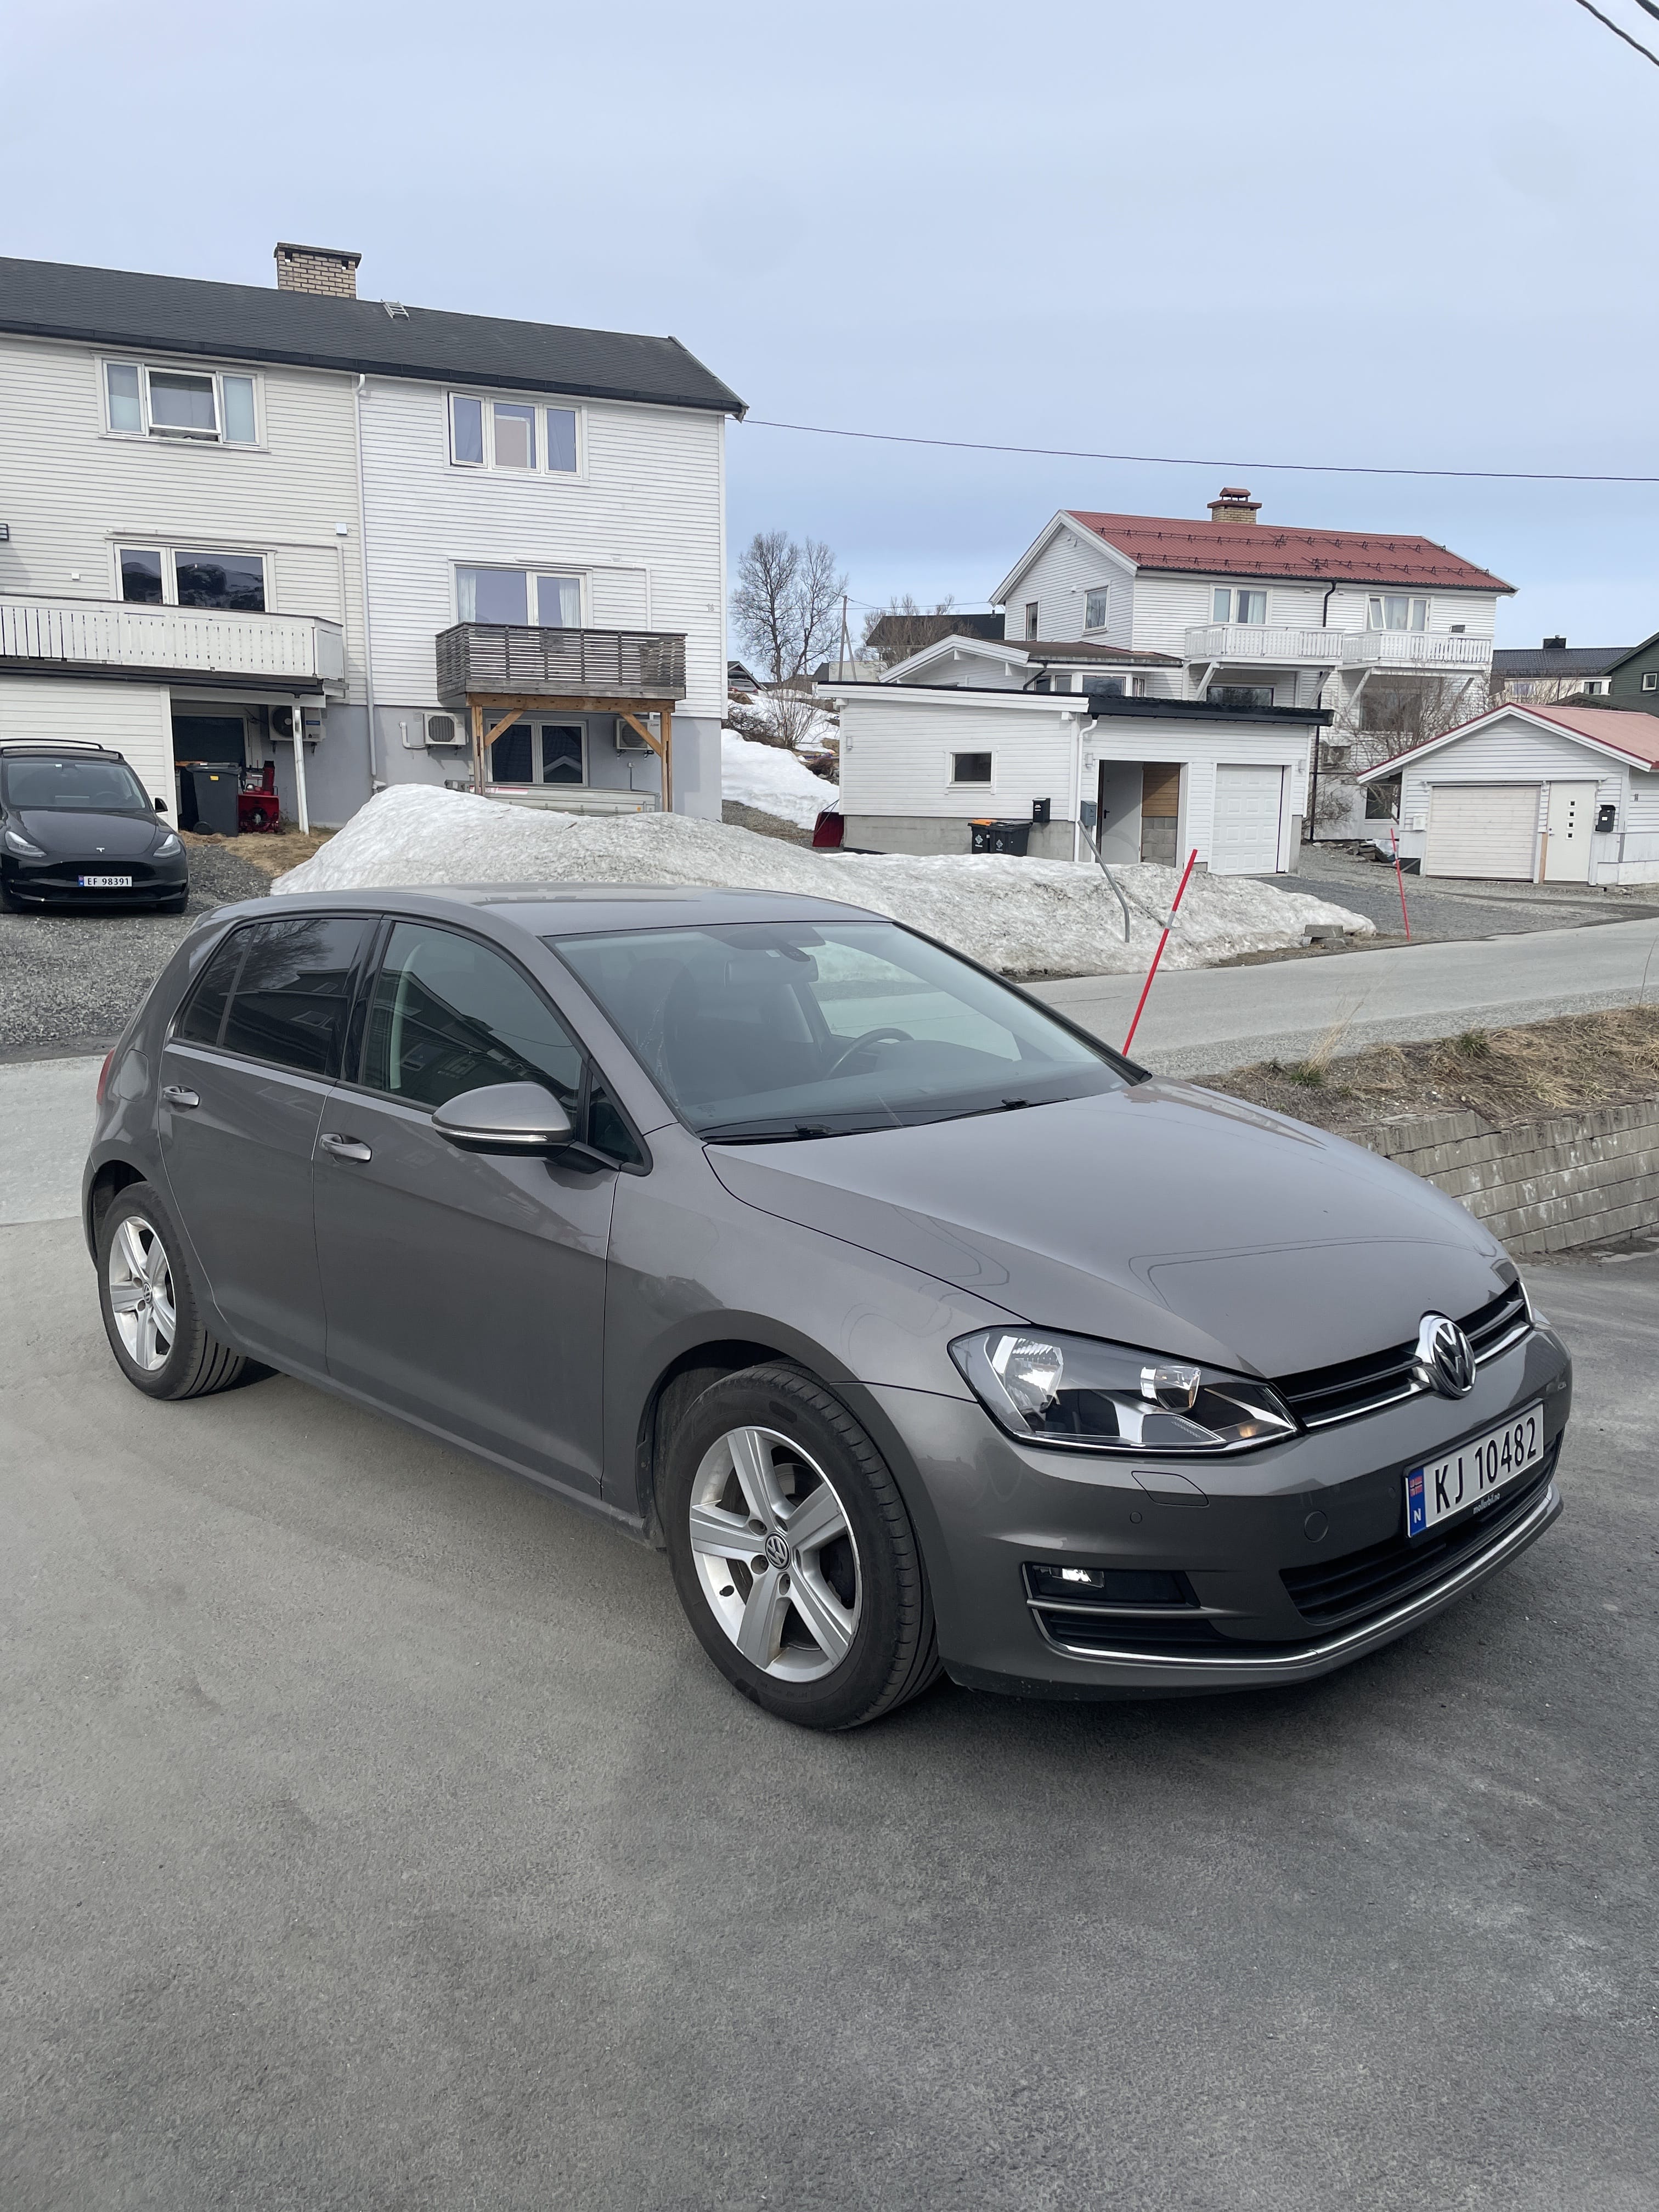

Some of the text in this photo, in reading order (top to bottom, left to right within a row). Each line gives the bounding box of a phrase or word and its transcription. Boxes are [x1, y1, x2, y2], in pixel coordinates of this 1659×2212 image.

[1435, 1417, 1537, 1514] KJ 10482
[1413, 1508, 1422, 1523] N
